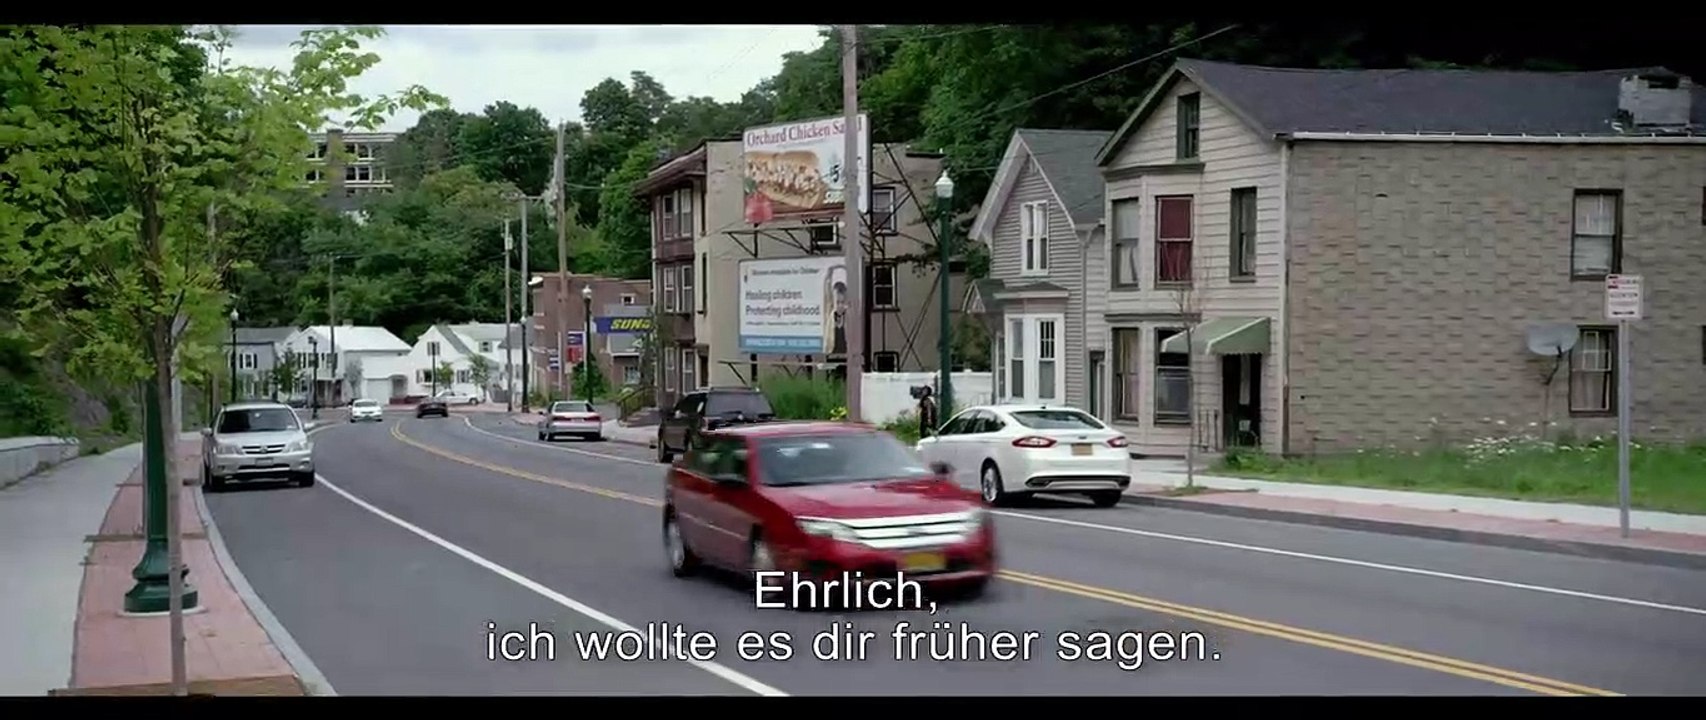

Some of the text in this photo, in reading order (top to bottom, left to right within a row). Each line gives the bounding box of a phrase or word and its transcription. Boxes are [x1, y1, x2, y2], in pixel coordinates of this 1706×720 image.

[747, 127, 787, 146] Orchard
[788, 122, 830, 140] Chicken
[745, 290, 772, 303] Healing
[745, 304, 782, 318] Protecting
